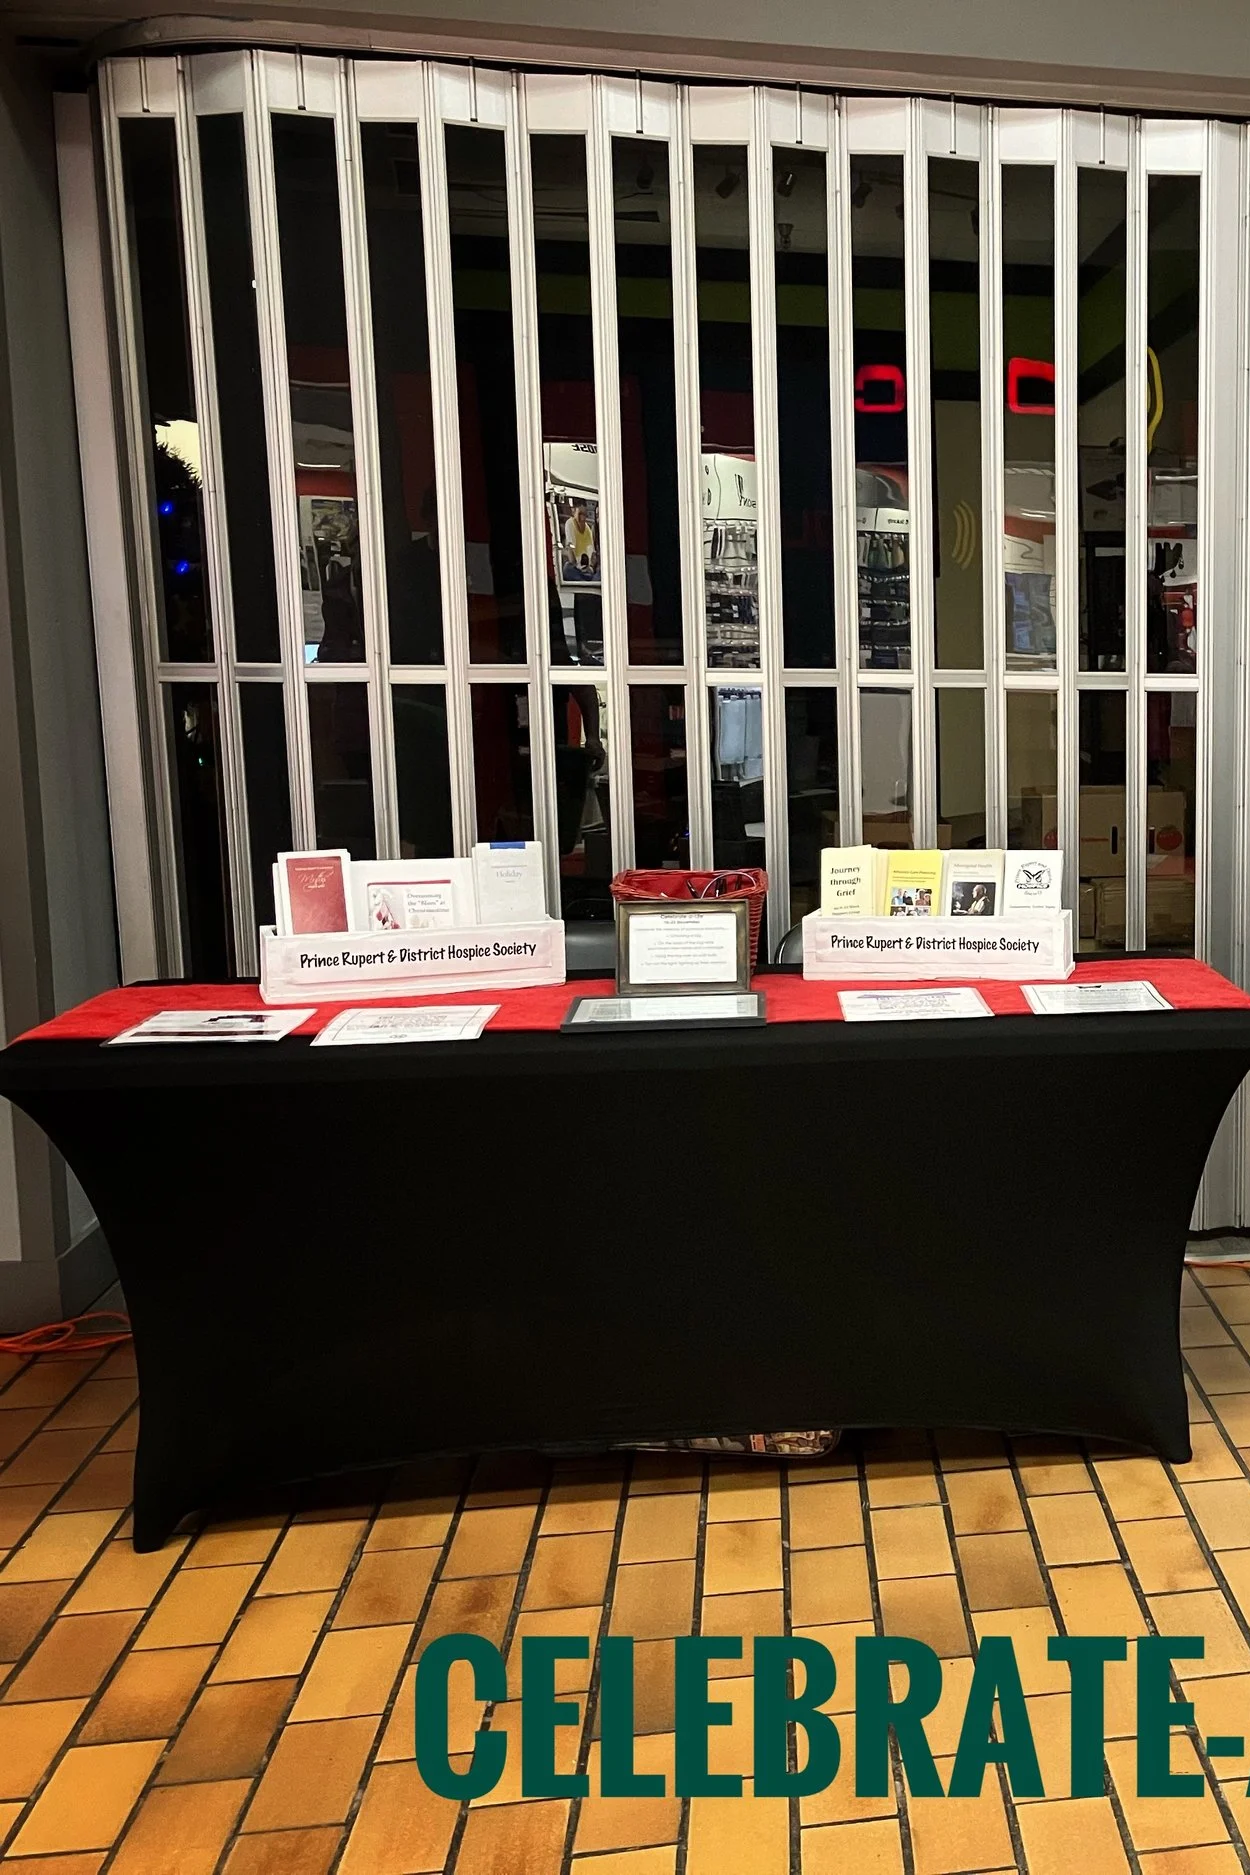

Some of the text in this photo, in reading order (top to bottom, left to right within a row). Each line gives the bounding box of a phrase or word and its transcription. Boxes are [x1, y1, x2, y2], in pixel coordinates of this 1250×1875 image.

[830, 866, 860, 874] Journey
[830, 877, 861, 886] through
[836, 889, 856, 897] Grief
[831, 935, 1040, 953] Prince Rupert & District Hospice Society
[300, 942, 537, 968] Prince Rupert & District Hospice Society
